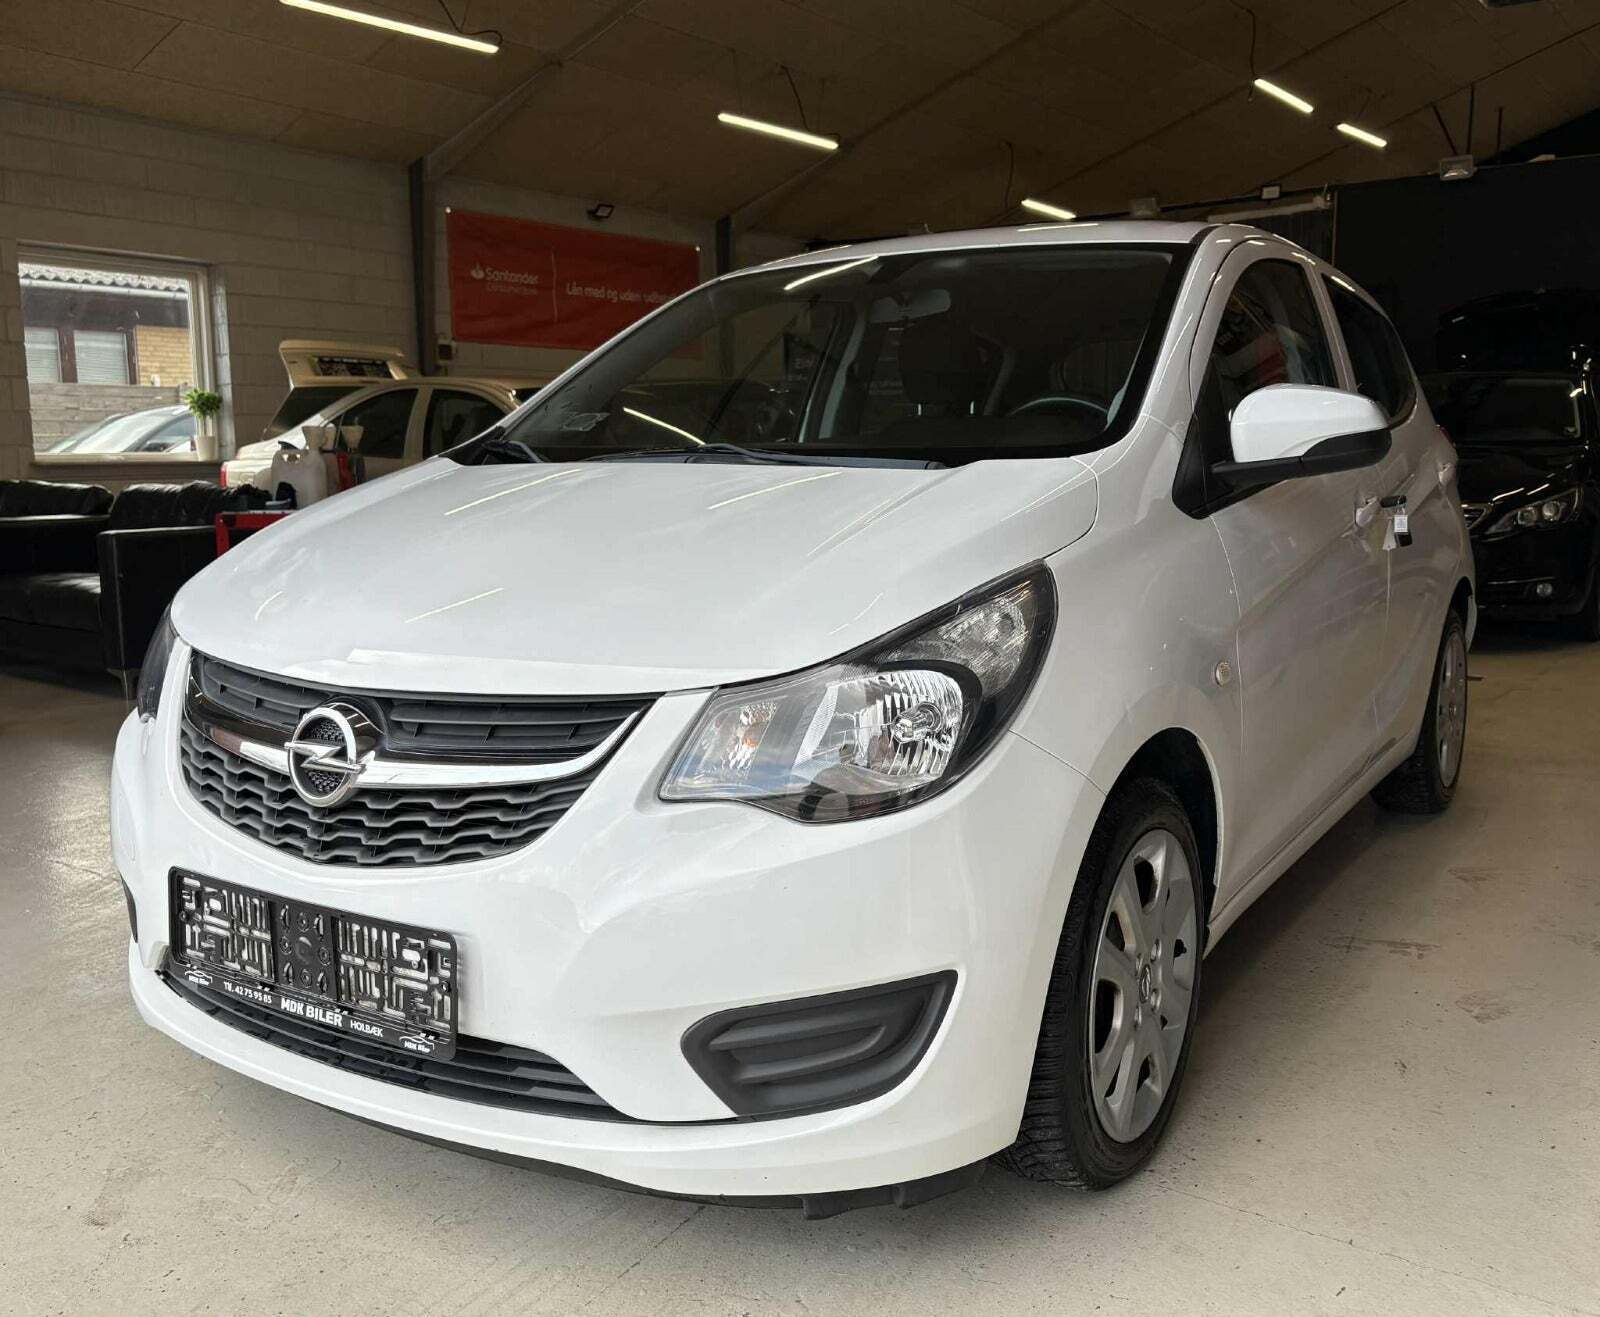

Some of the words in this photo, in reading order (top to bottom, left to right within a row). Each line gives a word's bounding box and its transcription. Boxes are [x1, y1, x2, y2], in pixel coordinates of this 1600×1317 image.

[486, 266, 539, 285] Santander
[566, 281, 583, 296] Lån
[584, 286, 605, 299] med
[607, 289, 618, 303] og
[235, 985, 244, 996] 42
[244, 988, 253, 998] 75
[253, 991, 263, 1001] 95
[280, 997, 304, 1017] MDK
[306, 1004, 342, 1027] BILER
[350, 1019, 384, 1038] HOLBÆK
